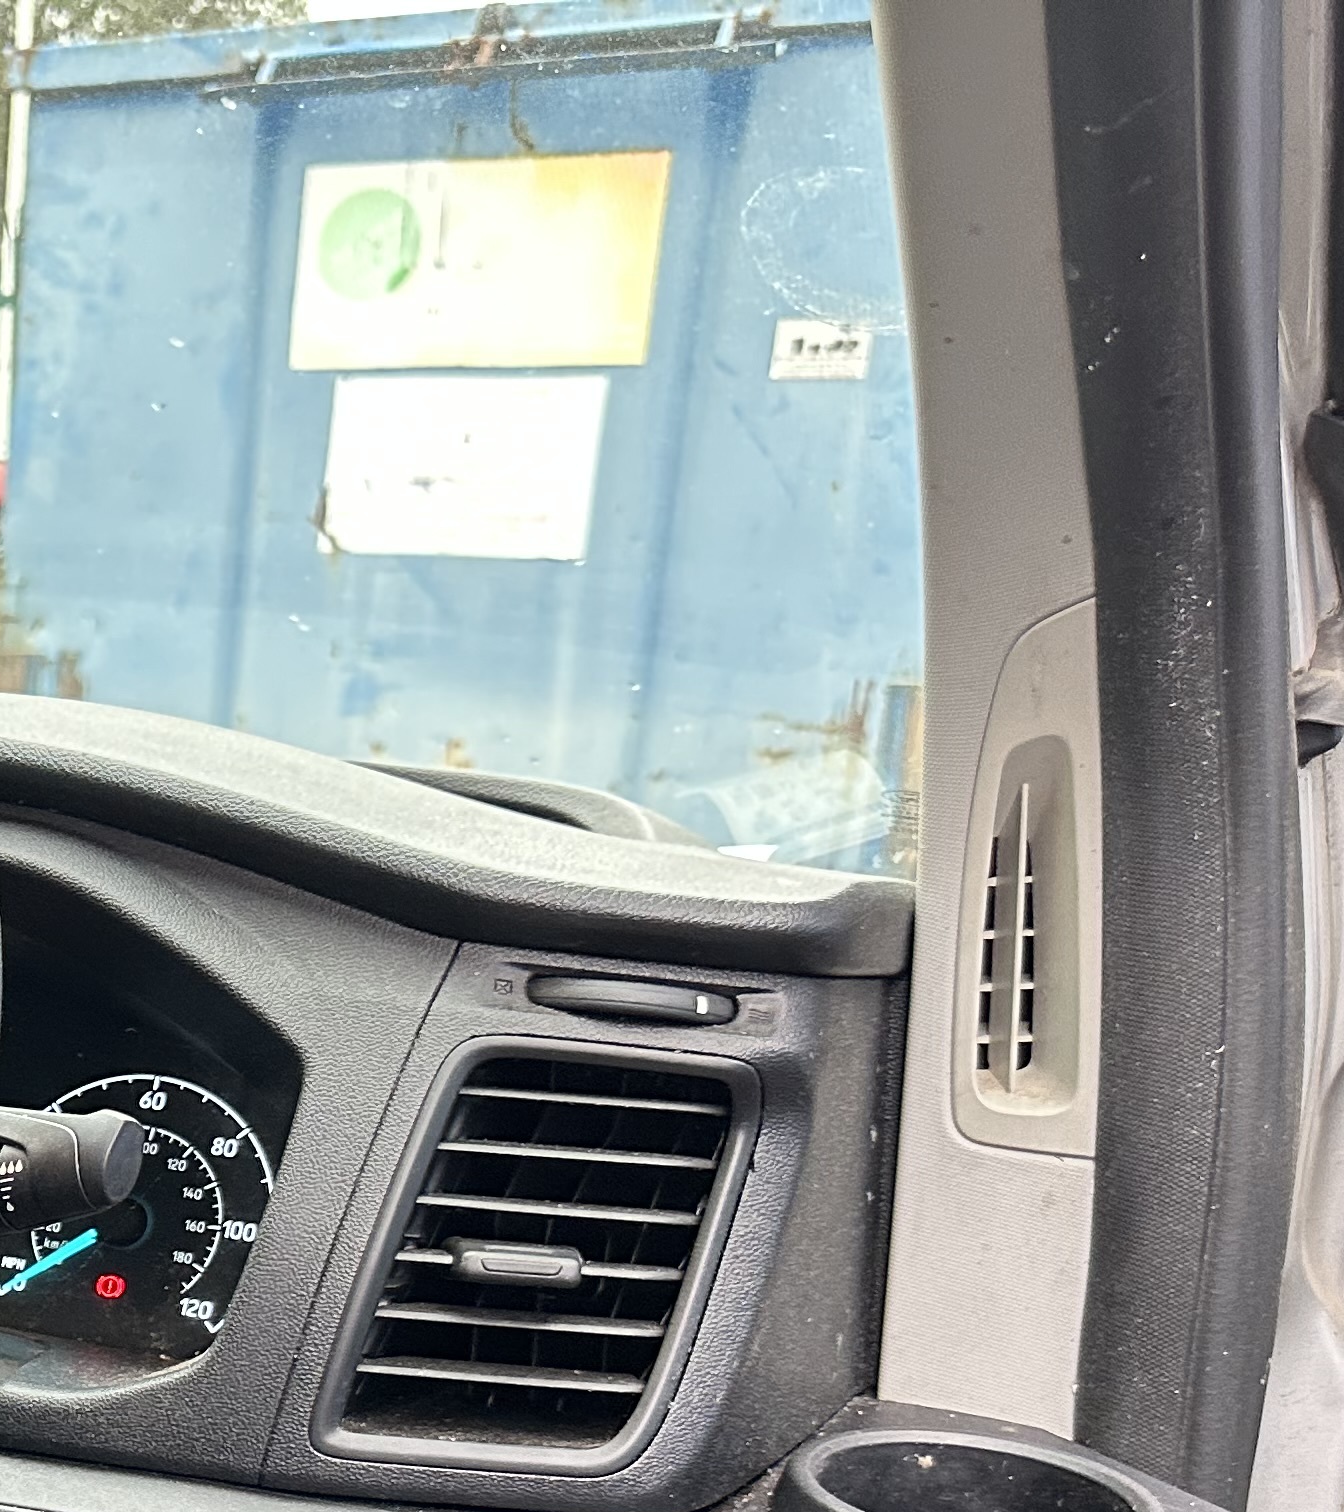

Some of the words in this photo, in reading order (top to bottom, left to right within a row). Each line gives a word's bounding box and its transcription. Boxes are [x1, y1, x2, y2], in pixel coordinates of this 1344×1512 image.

[139, 1091, 167, 1110] 60
[143, 1142, 158, 1155] 00
[210, 1137, 238, 1157] 80
[167, 1157, 187, 1172] 120
[182, 1186, 203, 1201] 140
[184, 1219, 206, 1233] 160
[222, 1221, 257, 1243] 100
[1, 1256, 27, 1271] MPH
[172, 1250, 193, 1264] 180
[179, 1298, 214, 1319] 120
